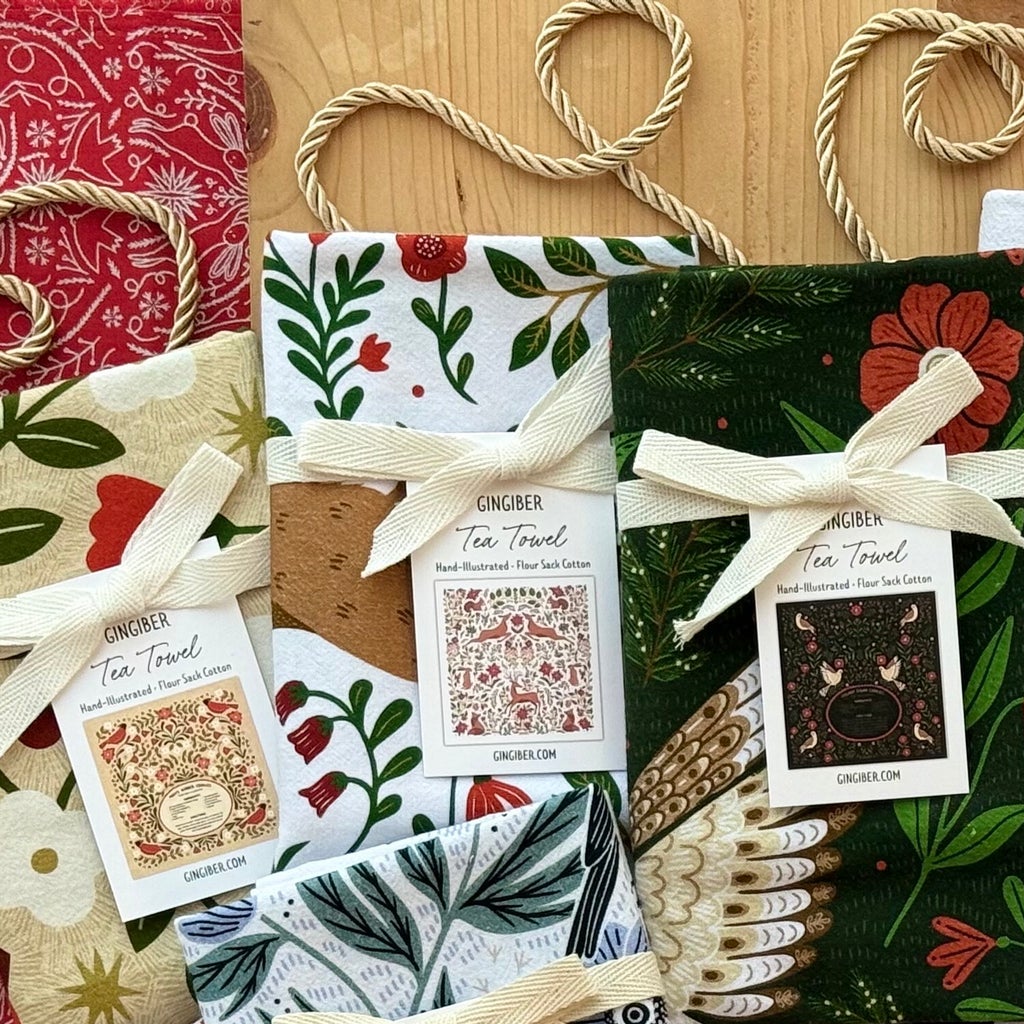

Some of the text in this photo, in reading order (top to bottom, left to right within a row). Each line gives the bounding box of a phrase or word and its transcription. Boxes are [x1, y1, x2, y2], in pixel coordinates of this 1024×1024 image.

[477, 495, 544, 512] GINGIBER
[820, 511, 883, 531] INGIBER
[456, 524, 568, 552] Tea Towel
[436, 558, 591, 572] Hand-Illustrated Flour Sack Cotton
[797, 540, 908, 572] Tea Towel
[777, 574, 932, 594] Hand-Illustrated Flour Sack Cotton
[104, 612, 171, 643] GINGIBER
[91, 634, 202, 687] Tea Towel
[80, 664, 232, 713] Hand-Illustrated Flour Sack Cotton
[493, 750, 556, 761] GINGIBER.COM
[837, 770, 900, 785] GINGIBER.COM
[184, 856, 247, 882] GINGIBER.COM
